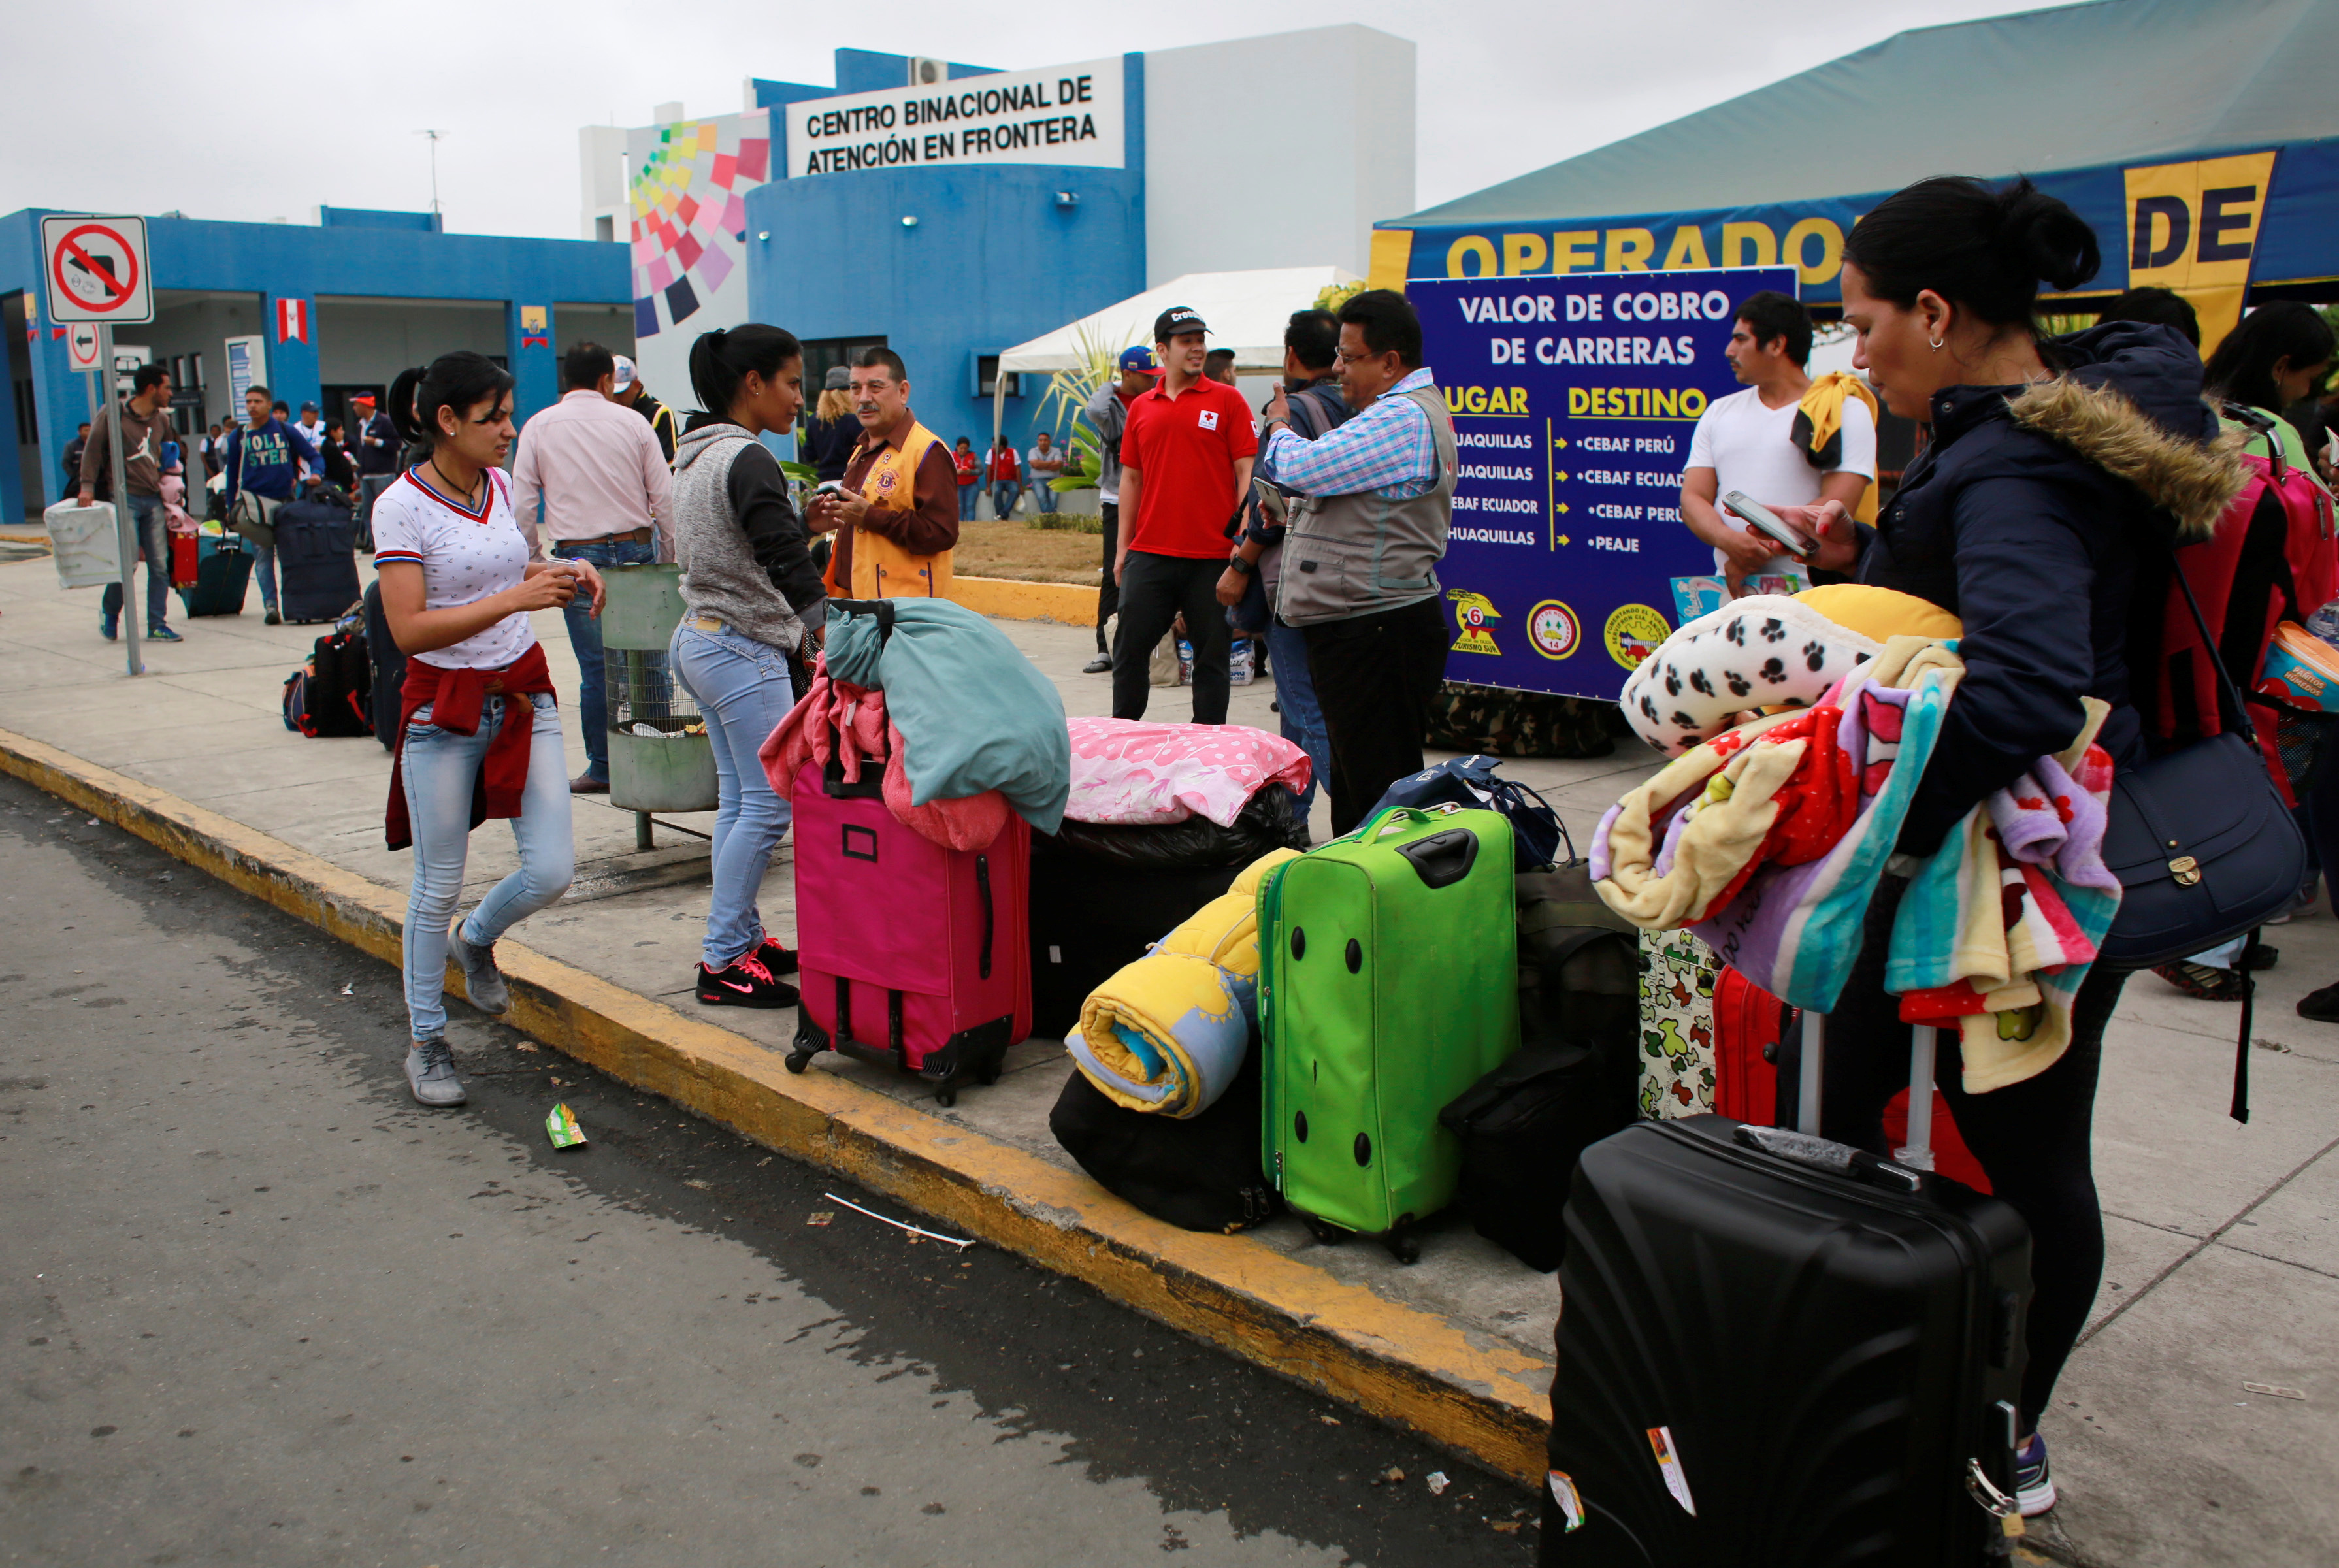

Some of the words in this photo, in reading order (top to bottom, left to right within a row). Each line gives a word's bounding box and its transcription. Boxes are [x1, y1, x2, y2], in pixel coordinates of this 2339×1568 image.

[807, 104, 895, 138] CENTRO
[904, 83, 1052, 126] BINACIONAL
[1058, 75, 1092, 106] DE
[807, 134, 915, 174] ATENCIÓN
[924, 133, 954, 160] EN
[963, 114, 1096, 155] FRONTERA
[1446, 217, 1863, 286] OPERADO
[2131, 185, 2257, 269] DE
[1458, 295, 1556, 323] VALOR
[1566, 293, 1603, 321] DE
[1612, 290, 1730, 323] COBRO
[1491, 338, 1526, 365] DE
[1535, 336, 1695, 365] CARRERAS
[1445, 386, 1529, 414] UGAR
[1568, 387, 1707, 417] DESTINO
[1455, 433, 1532, 449] UAQUILLAS
[1584, 436, 1631, 452] CEBAF
[1635, 435, 1675, 454] PERÚ
[1456, 465, 1533, 481] UAQUILLAS
[1584, 469, 1631, 485] CEBAF
[1635, 472, 1685, 488] ECUAD
[1451, 497, 1479, 510] EBAF
[1482, 498, 1539, 514] ECUADOR
[1596, 504, 1643, 520] CEBAF
[1447, 527, 1535, 546] HUAQUILLAS
[1595, 536, 1639, 553] PEAJE
[1470, 609, 1481, 623] 6
[1455, 643, 1482, 651] TURISMO
[1484, 645, 1498, 653] SUR
[2283, 672, 2321, 697] HÚMEDOS
[2292, 666, 2325, 689] PAÑITOS
